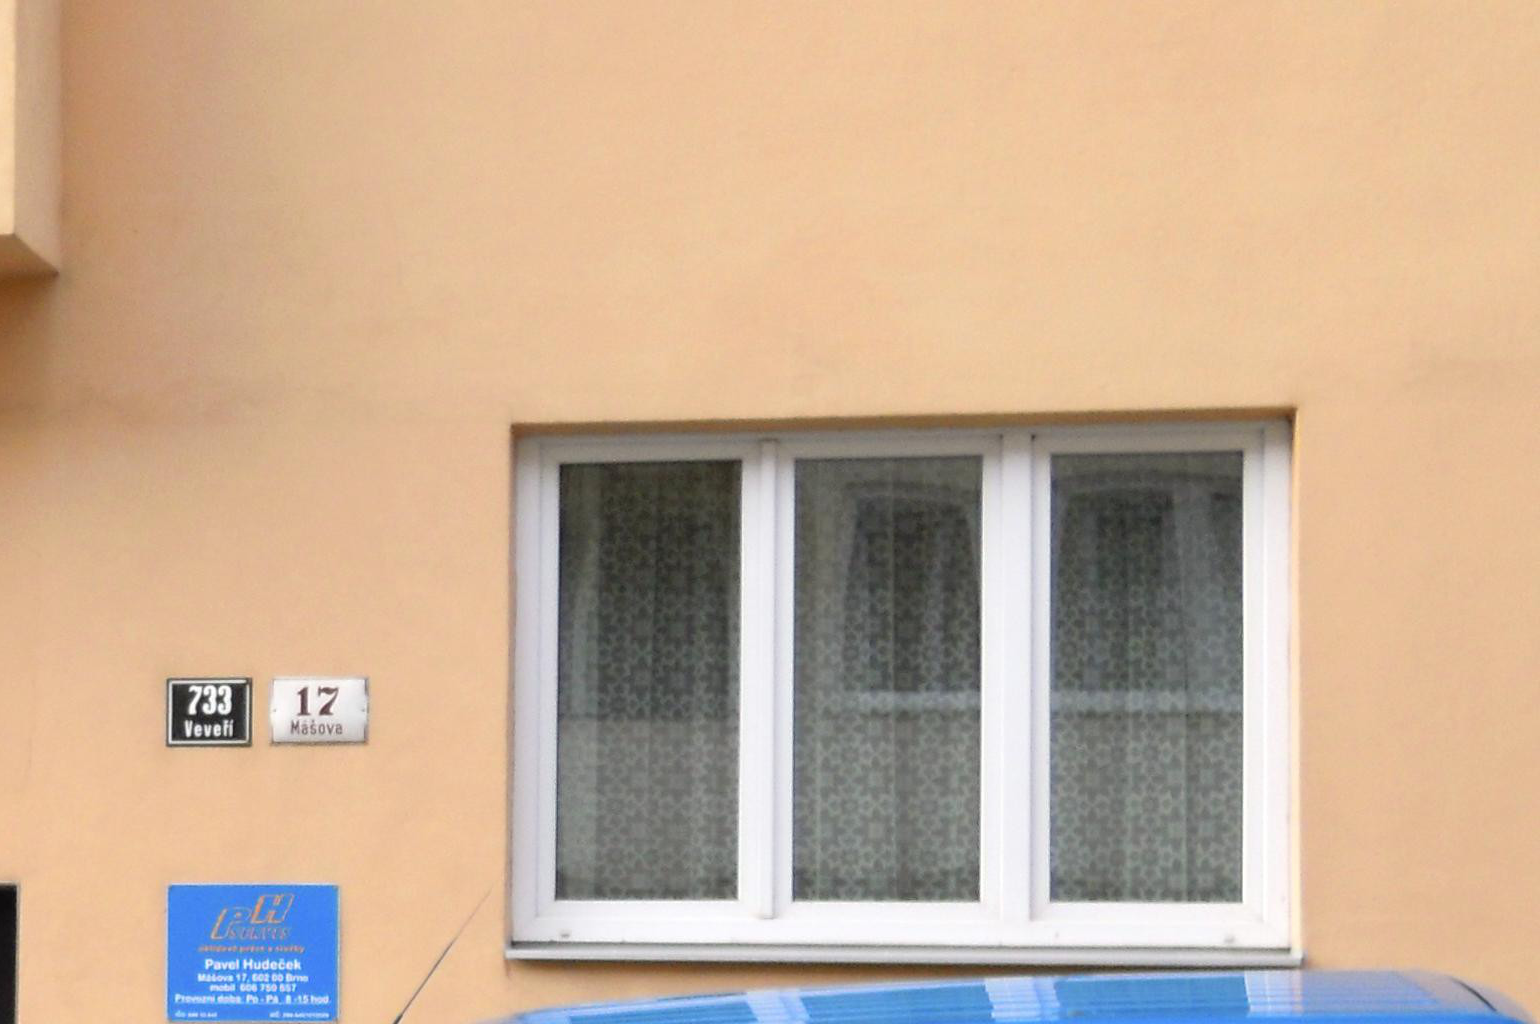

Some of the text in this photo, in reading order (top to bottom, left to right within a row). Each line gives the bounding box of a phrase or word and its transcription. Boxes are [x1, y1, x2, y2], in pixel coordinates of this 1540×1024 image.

[188, 685, 233, 715] 733
[297, 686, 339, 716] 17
[184, 720, 234, 738] Veveří
[290, 720, 343, 736] Mášova
[205, 958, 302, 970] Pavel Hudeček
[286, 973, 309, 982] Brno
